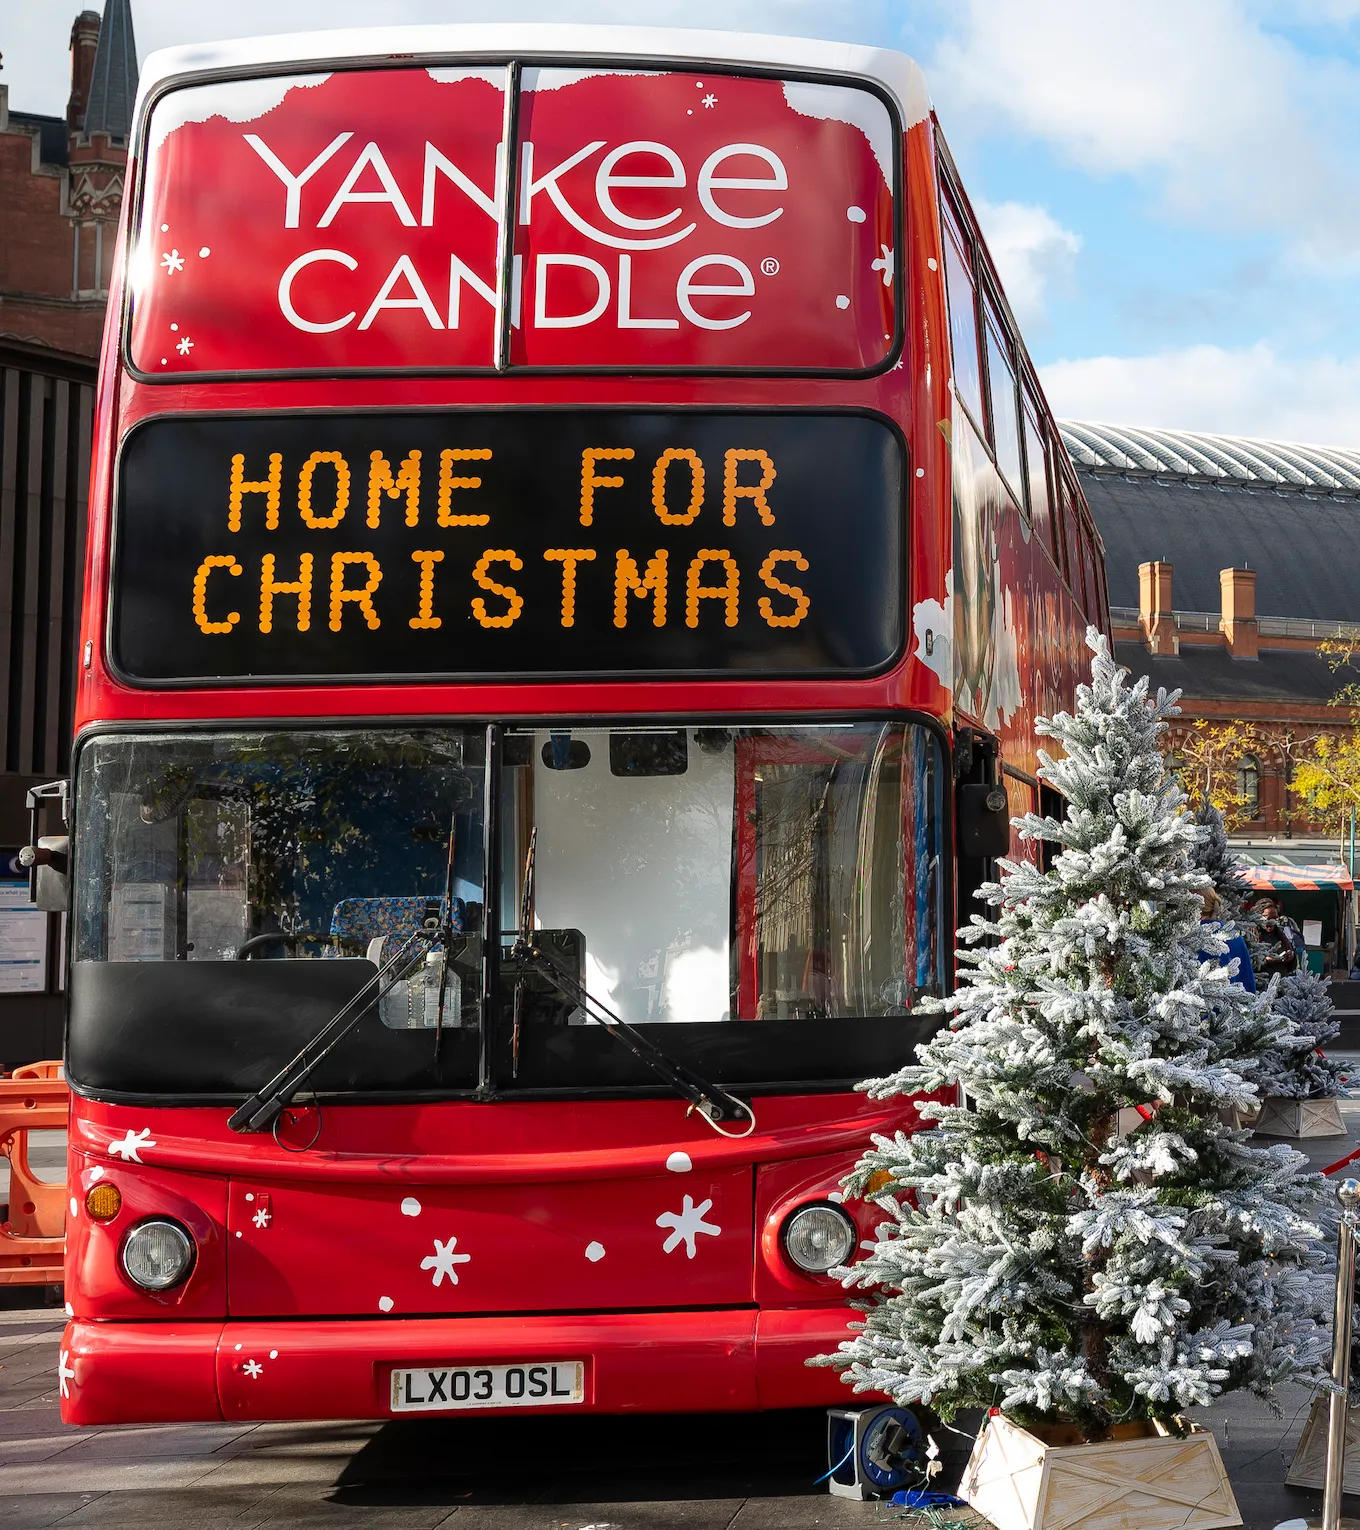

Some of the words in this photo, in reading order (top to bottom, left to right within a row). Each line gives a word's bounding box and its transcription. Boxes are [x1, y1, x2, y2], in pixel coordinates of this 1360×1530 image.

[228, 449, 492, 532] HOME
[580, 448, 775, 526] FOR
[193, 549, 810, 634] CHRISTMAS
[405, 1370, 493, 1404] LX03
[505, 1366, 570, 1398] OSL
